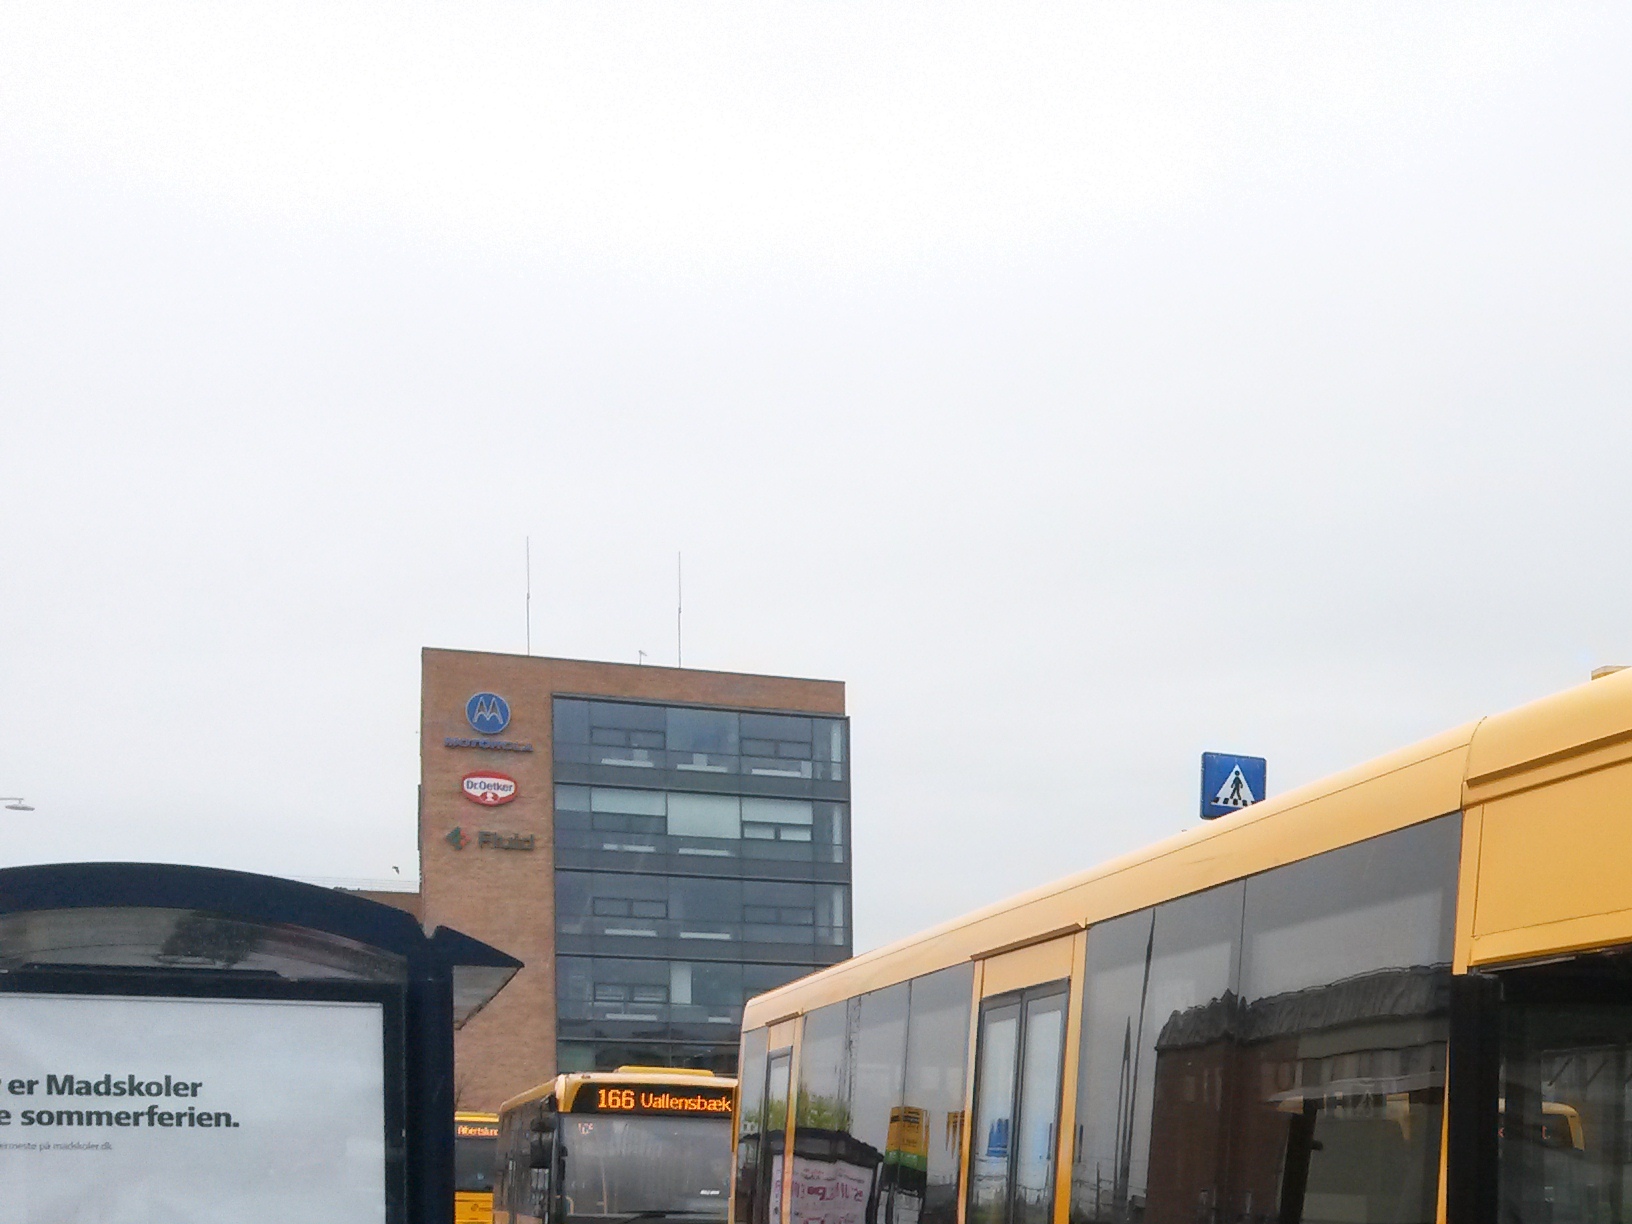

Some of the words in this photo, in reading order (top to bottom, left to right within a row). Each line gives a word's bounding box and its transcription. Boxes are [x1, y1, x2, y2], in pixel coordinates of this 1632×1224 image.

[8, 1077, 39, 1095] er
[46, 1073, 203, 1098] Madskoler
[598, 1089, 635, 1109] 166
[0, 1109, 12, 1126] e
[20, 1104, 241, 1128] sommerferien.
